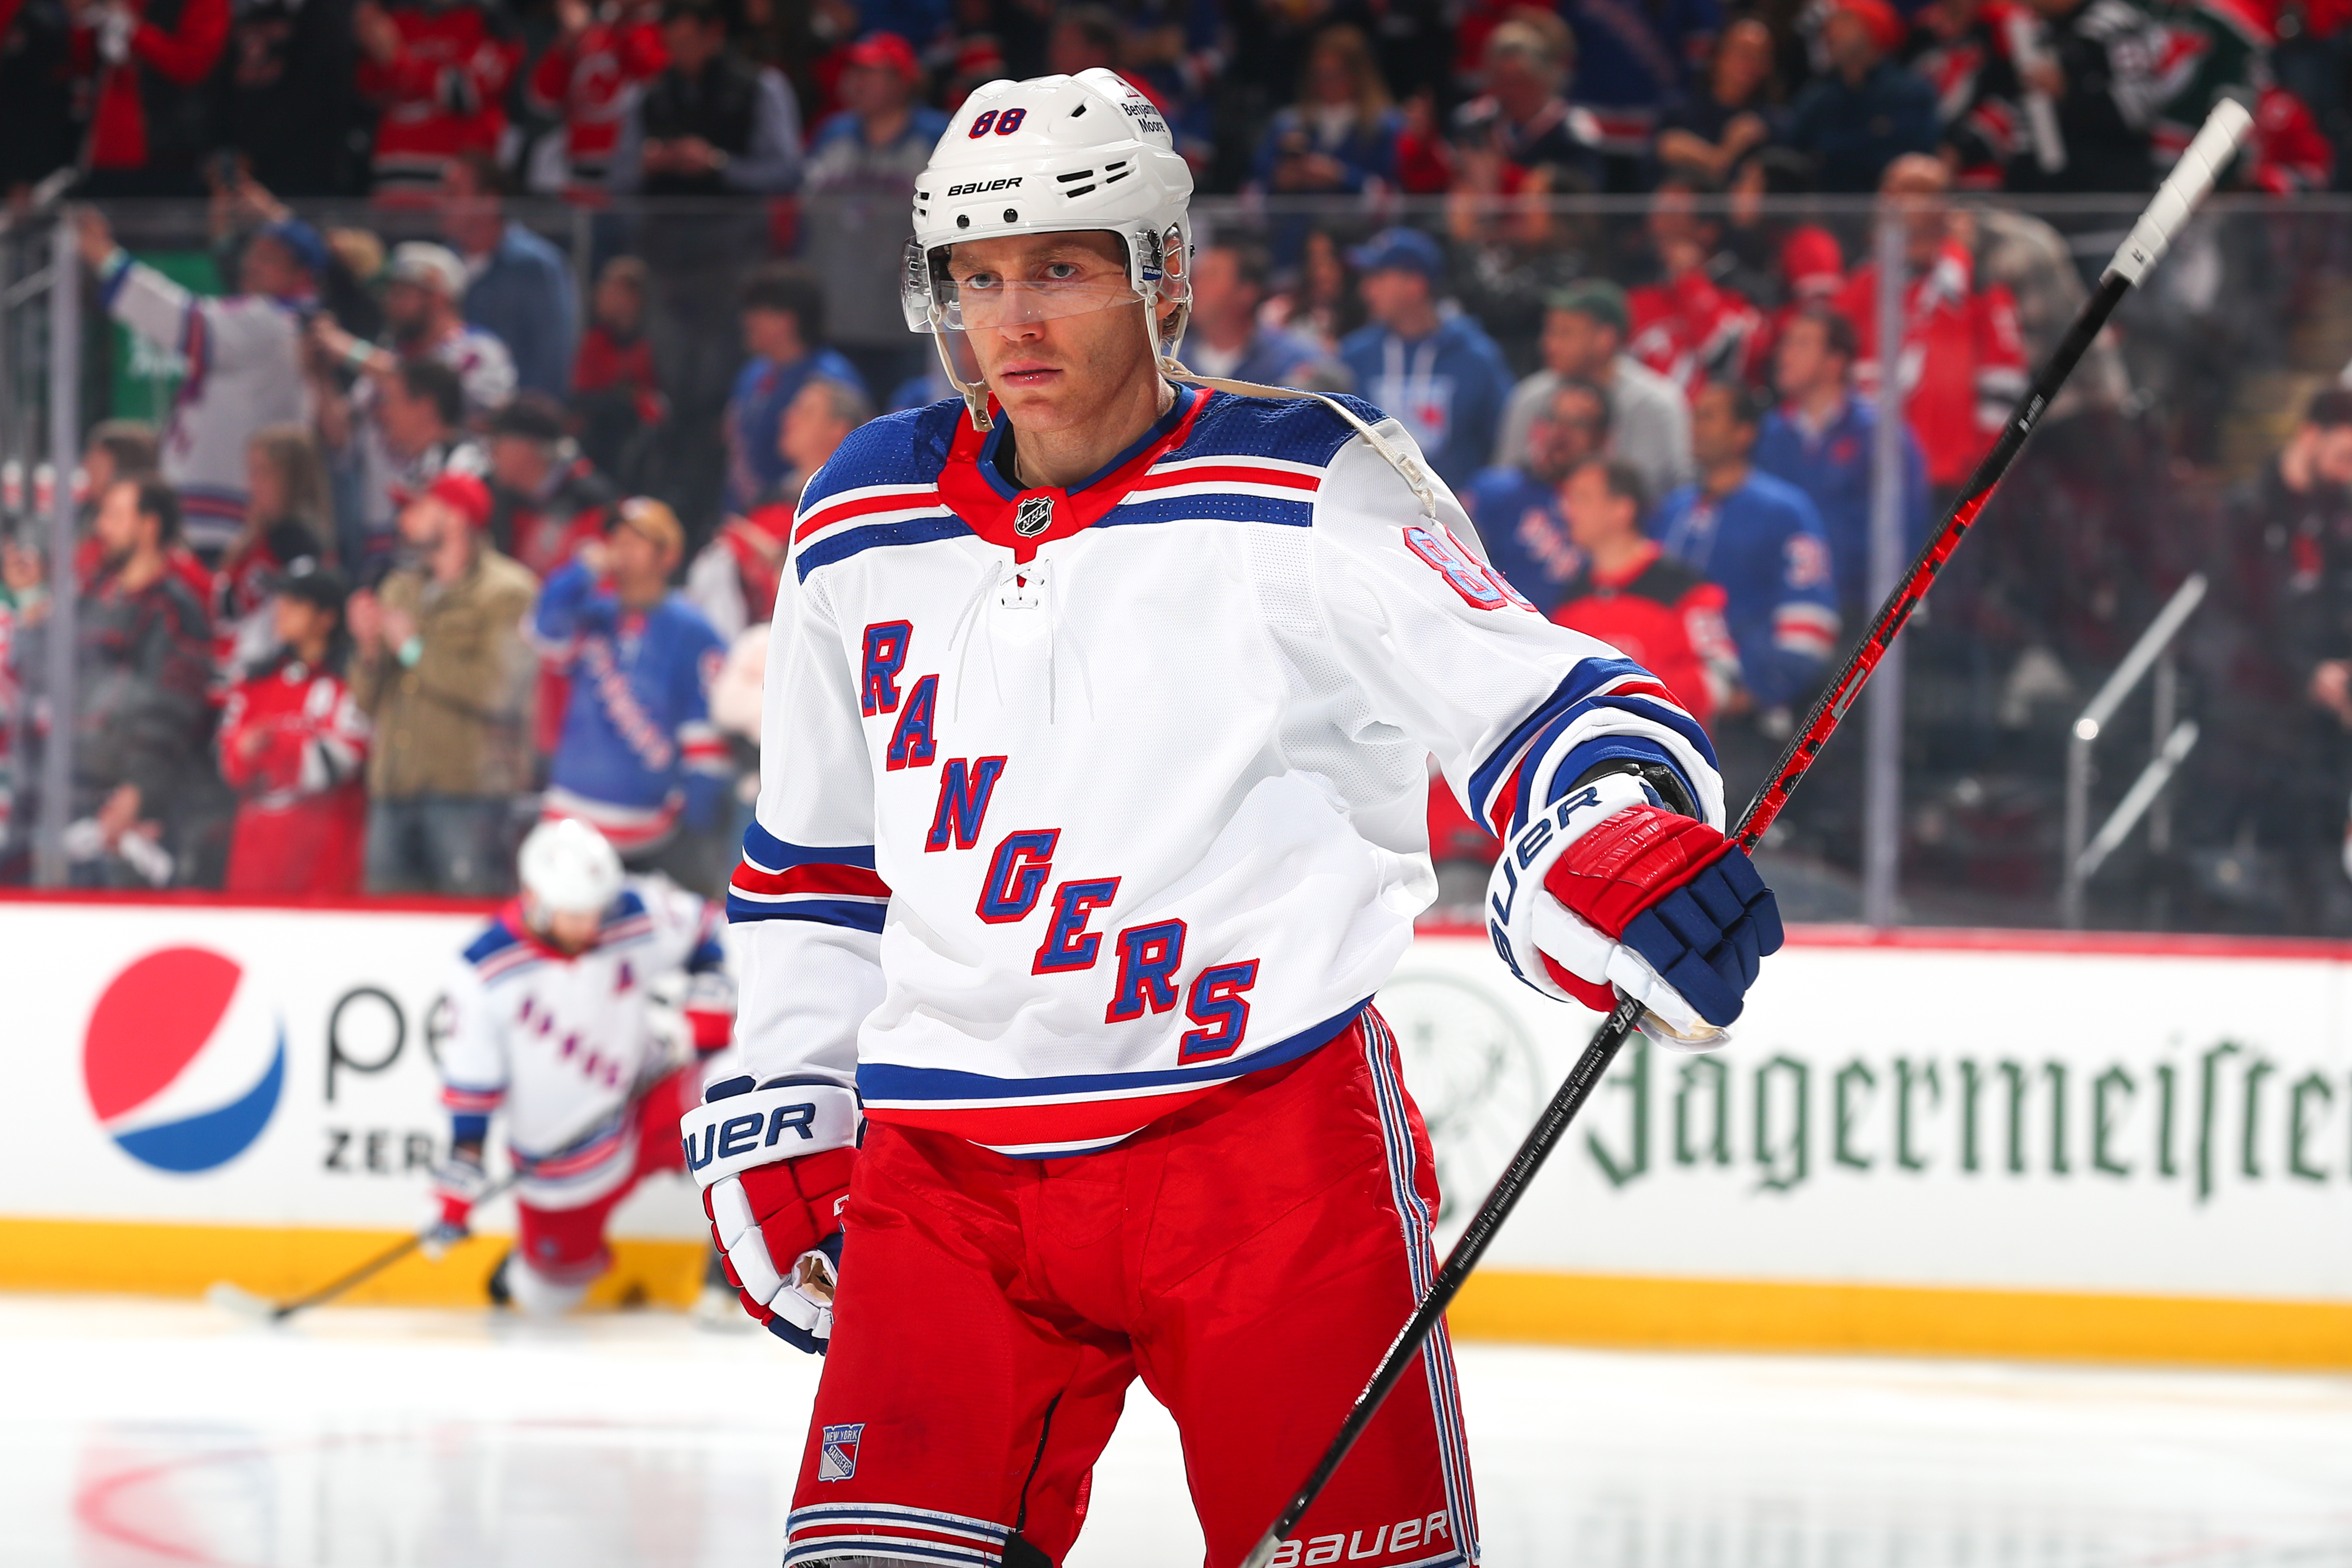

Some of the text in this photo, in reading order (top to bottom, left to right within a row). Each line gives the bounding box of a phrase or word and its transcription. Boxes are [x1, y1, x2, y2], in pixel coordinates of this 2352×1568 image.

[968, 108, 1027, 139] 88
[1137, 118, 1166, 133] Moore
[947, 177, 1023, 196] BAUER
[1022, 507, 1046, 529] NHL
[861, 619, 1260, 1066] RANGERS
[1575, 1049, 1605, 1086] DYNAMIC
[323, 1128, 436, 1174] ZER
[826, 1430, 858, 1442] NEW YORK
[828, 1445, 852, 1475] RANGERS
